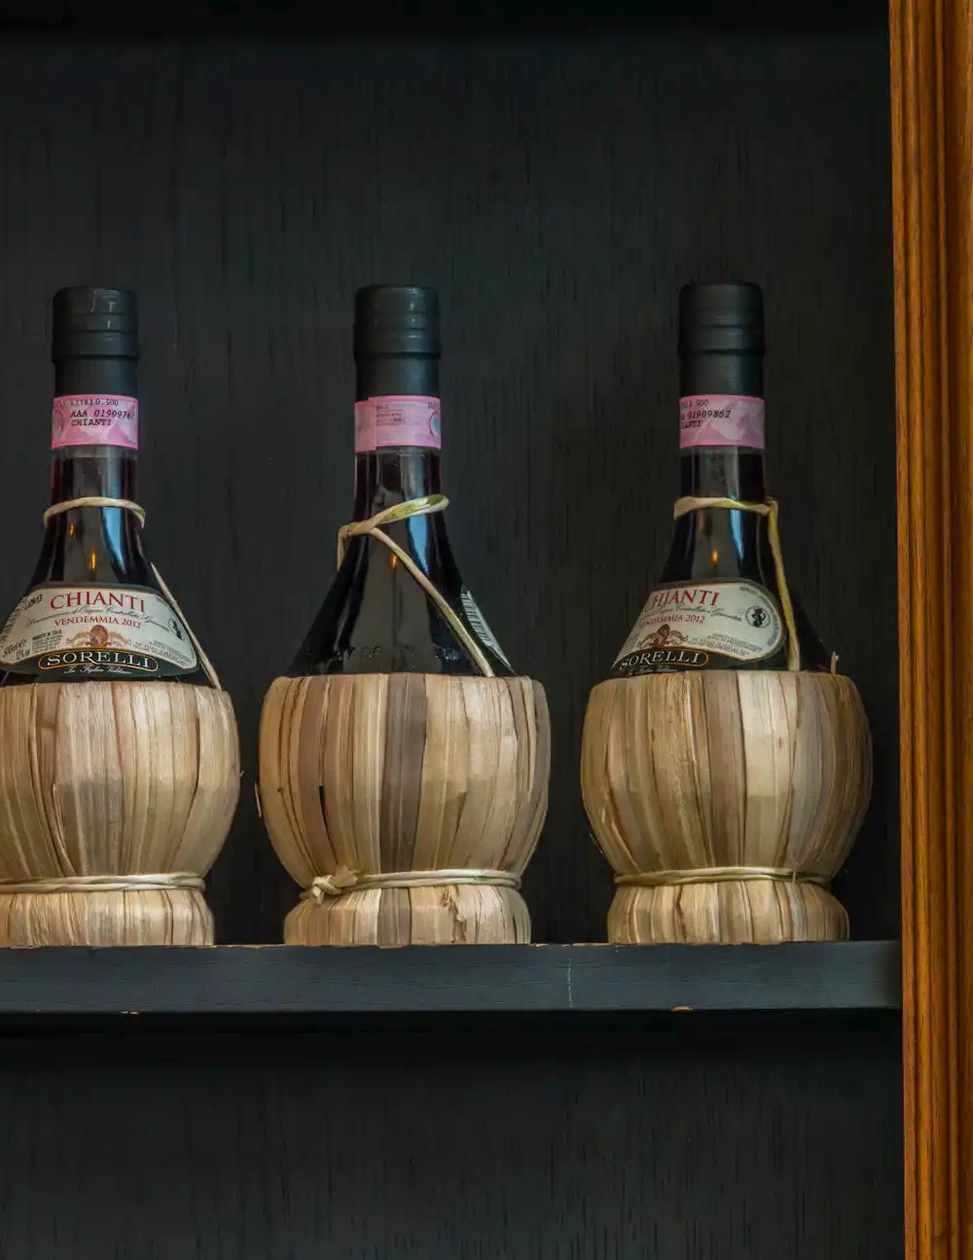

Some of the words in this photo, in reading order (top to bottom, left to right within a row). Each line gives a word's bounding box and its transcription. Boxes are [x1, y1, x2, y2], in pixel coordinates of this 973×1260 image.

[70, 409, 88, 418] AAA
[70, 419, 112, 427] CHIANTI
[50, 591, 145, 613] CHIANTI
[54, 616, 119, 626] VENDEMMIA
[121, 618, 142, 629] 2012
[685, 615, 706, 624] 2012
[47, 651, 150, 668] SORELLI
